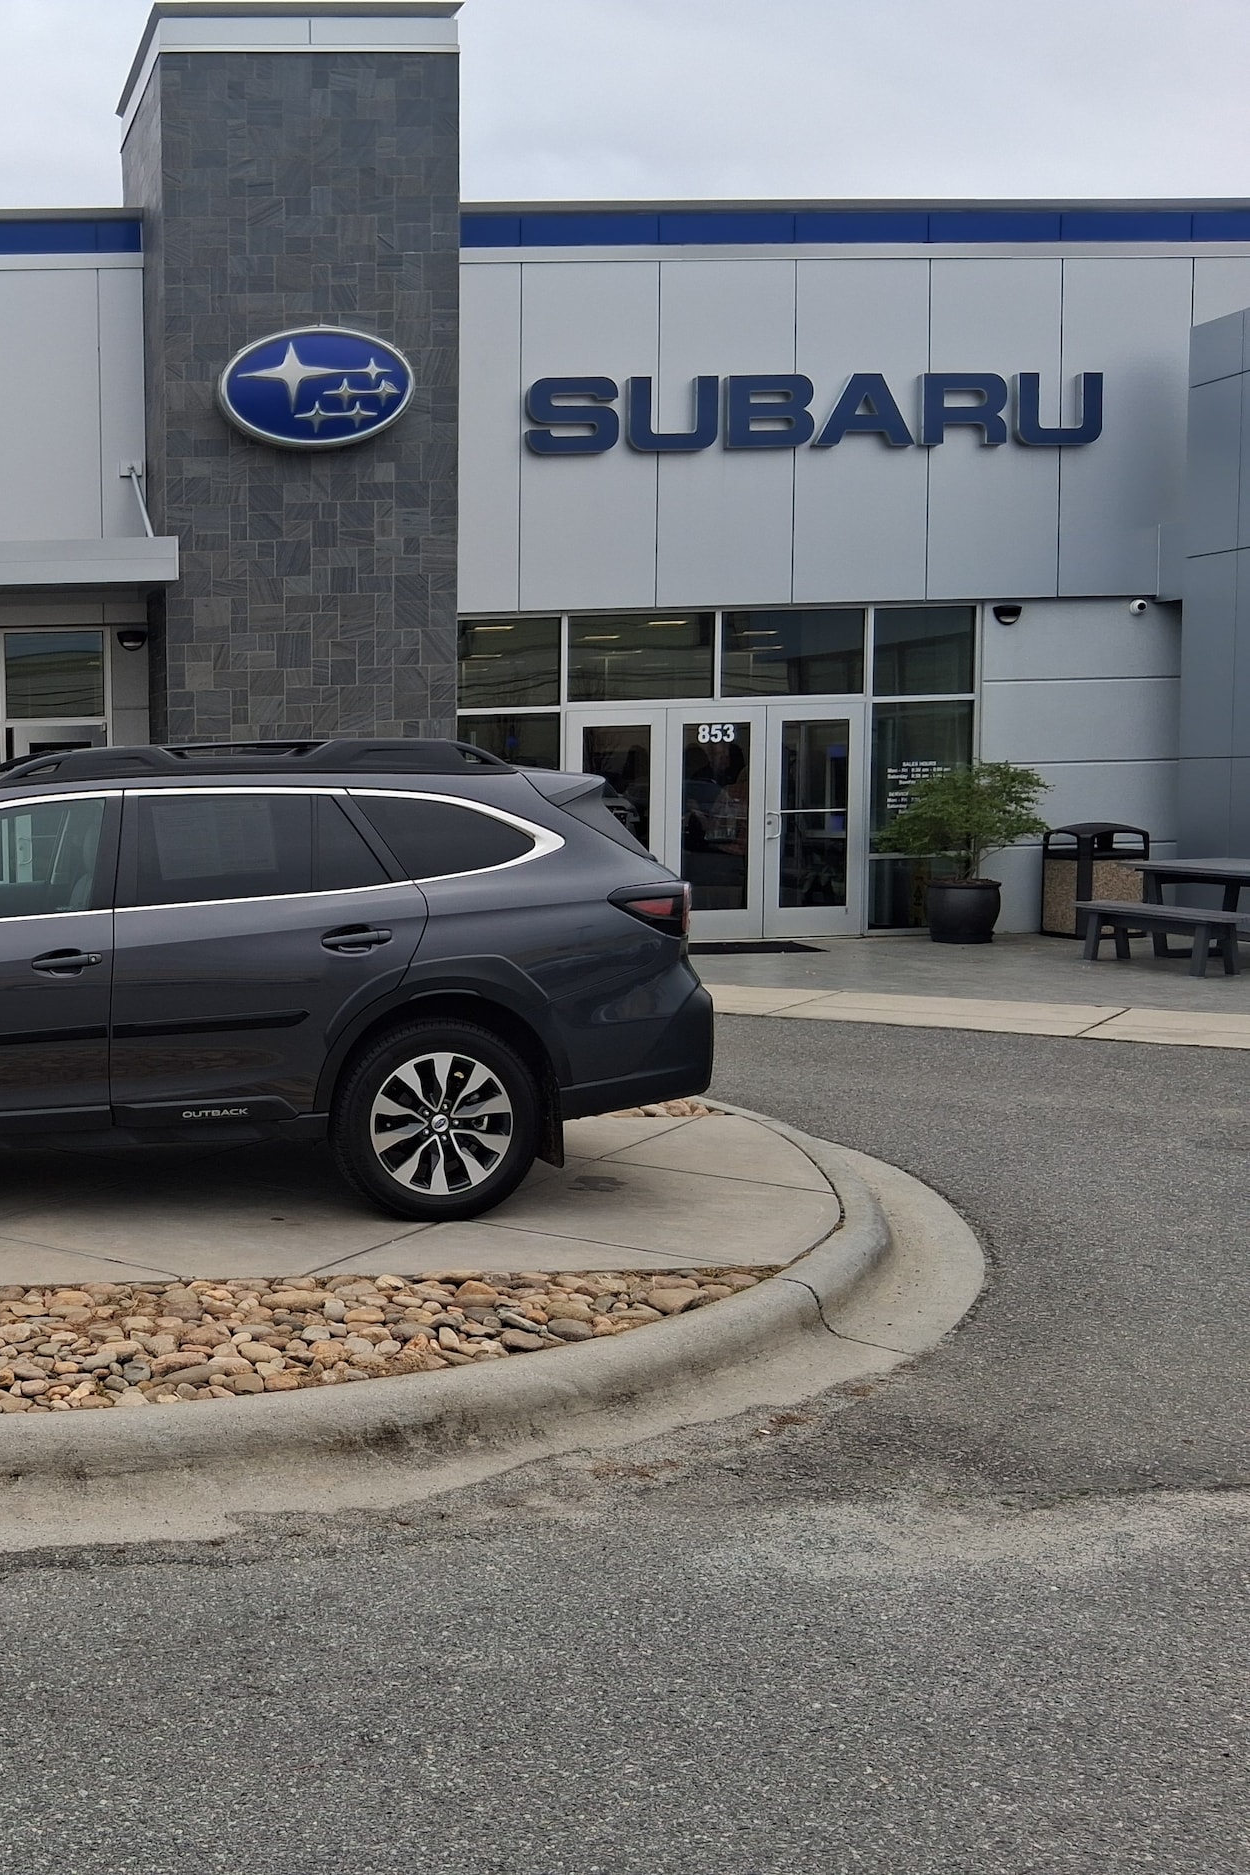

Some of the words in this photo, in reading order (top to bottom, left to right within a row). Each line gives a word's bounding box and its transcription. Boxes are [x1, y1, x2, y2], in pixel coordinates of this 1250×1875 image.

[525, 372, 1104, 456] SUBARU
[697, 724, 735, 743] 853
[182, 1108, 249, 1118] OUTBACK
